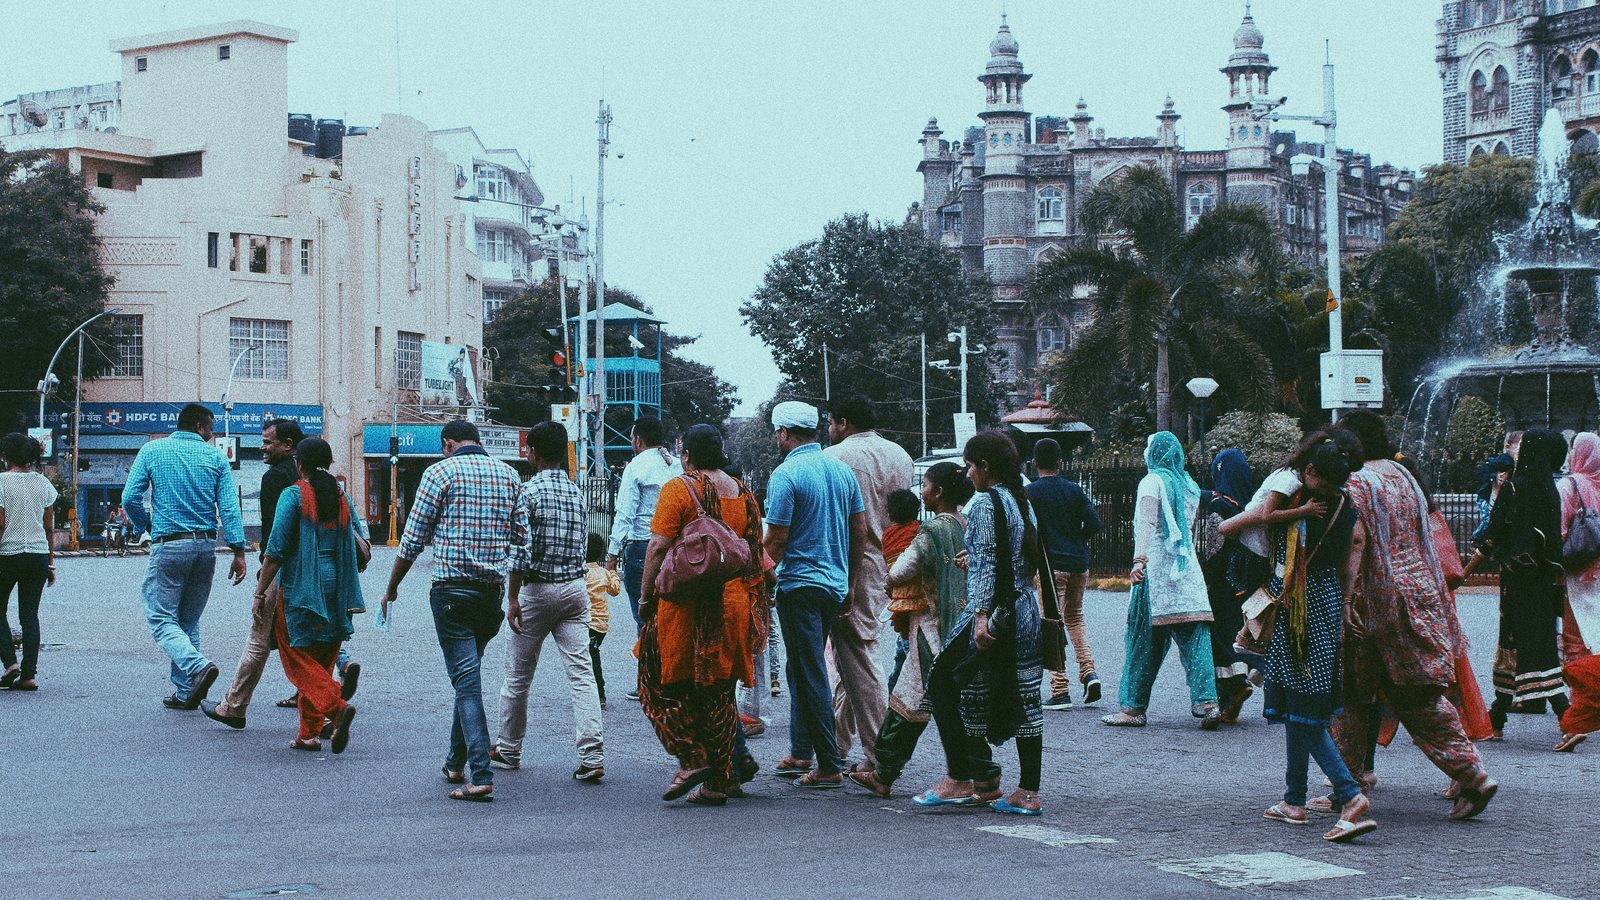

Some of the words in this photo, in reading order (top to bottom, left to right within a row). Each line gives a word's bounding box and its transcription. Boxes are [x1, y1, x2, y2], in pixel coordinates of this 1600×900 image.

[126, 413, 157, 421] HDFC
[300, 415, 322, 423] BANK
[398, 434, 414, 446] citi
